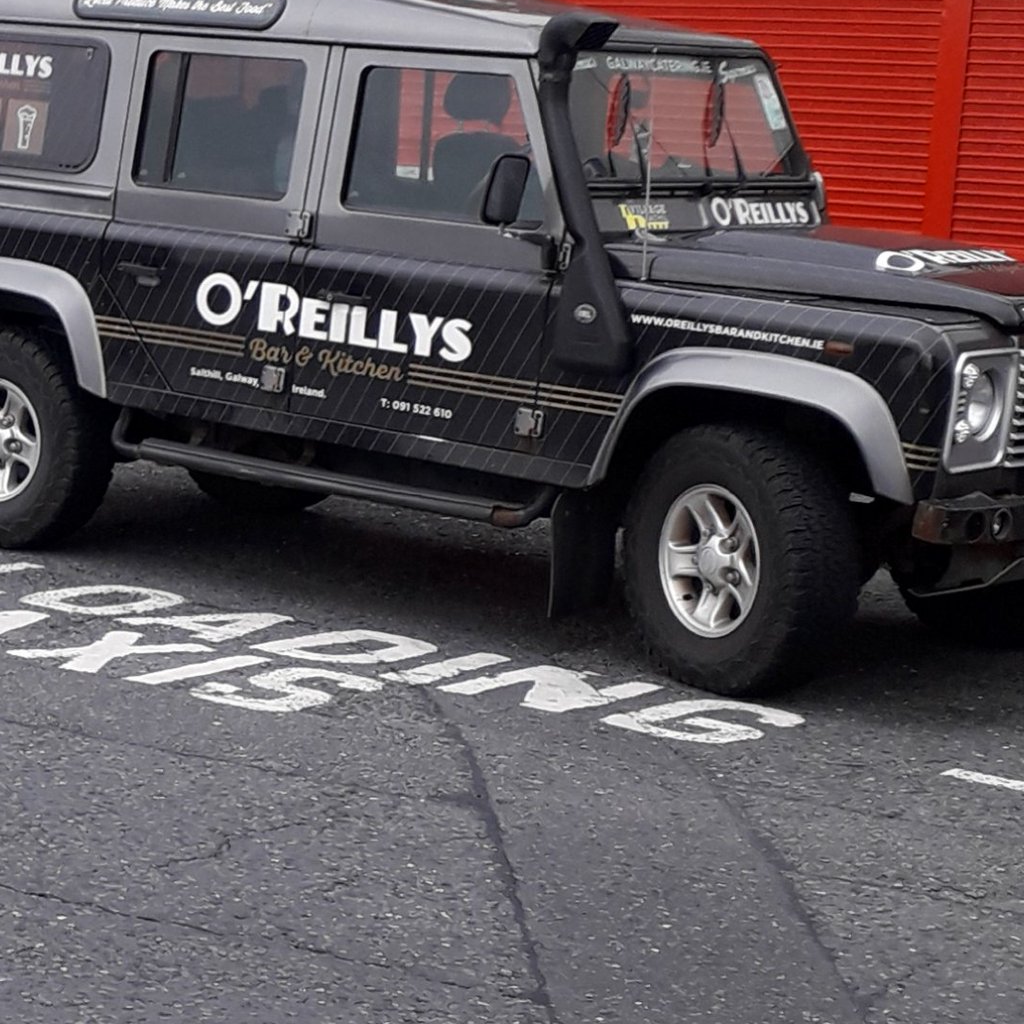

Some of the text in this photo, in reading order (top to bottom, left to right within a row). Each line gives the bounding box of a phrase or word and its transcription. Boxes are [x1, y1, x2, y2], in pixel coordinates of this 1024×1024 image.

[711, 196, 810, 226] O'REILLYS
[196, 272, 472, 362] O'REILLYS
[630, 313, 825, 351] WWW.OREILLYSBARANDKITCHEN.IE
[248, 337, 404, 382] Bar & Kitchen
[189, 366, 328, 399] Salthill, Galway, Ireland.
[379, 397, 453, 419] T: 091 522 610
